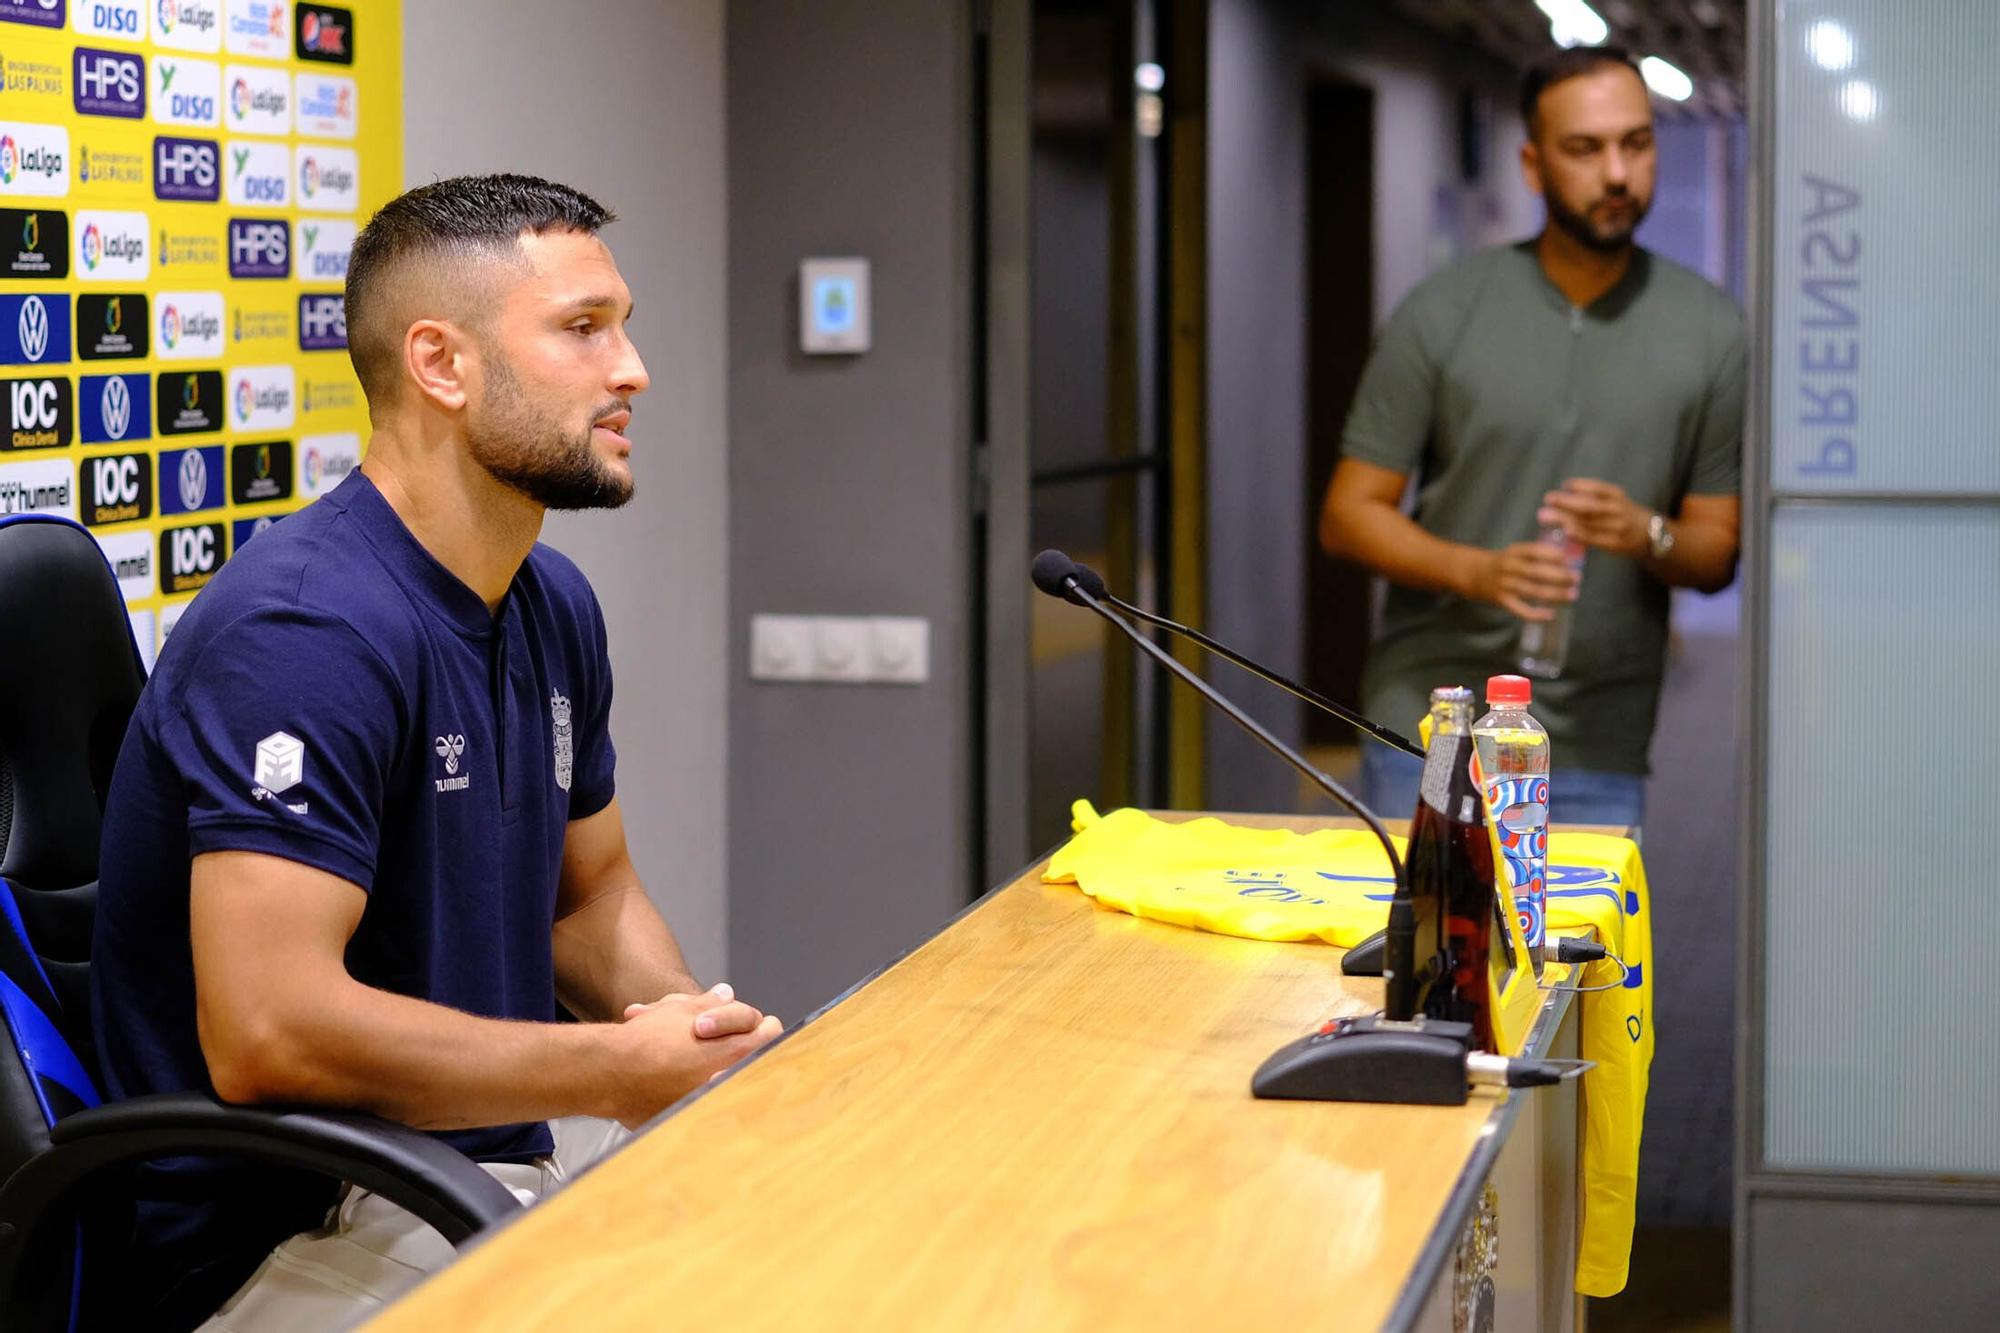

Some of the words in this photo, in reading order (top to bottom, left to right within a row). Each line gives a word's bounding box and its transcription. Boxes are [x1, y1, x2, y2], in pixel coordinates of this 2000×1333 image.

[80, 54, 140, 103] HPS
[21, 147, 62, 178] LaLiga
[159, 143, 216, 187] HPS
[103, 235, 143, 263] LaLiga
[232, 224, 287, 265] HPS
[11, 380, 58, 429] IOC
[19, 477, 70, 511] hummel
[94, 456, 139, 506] IOC
[115, 549, 150, 579] mmel
[172, 526, 214, 574] IOC
